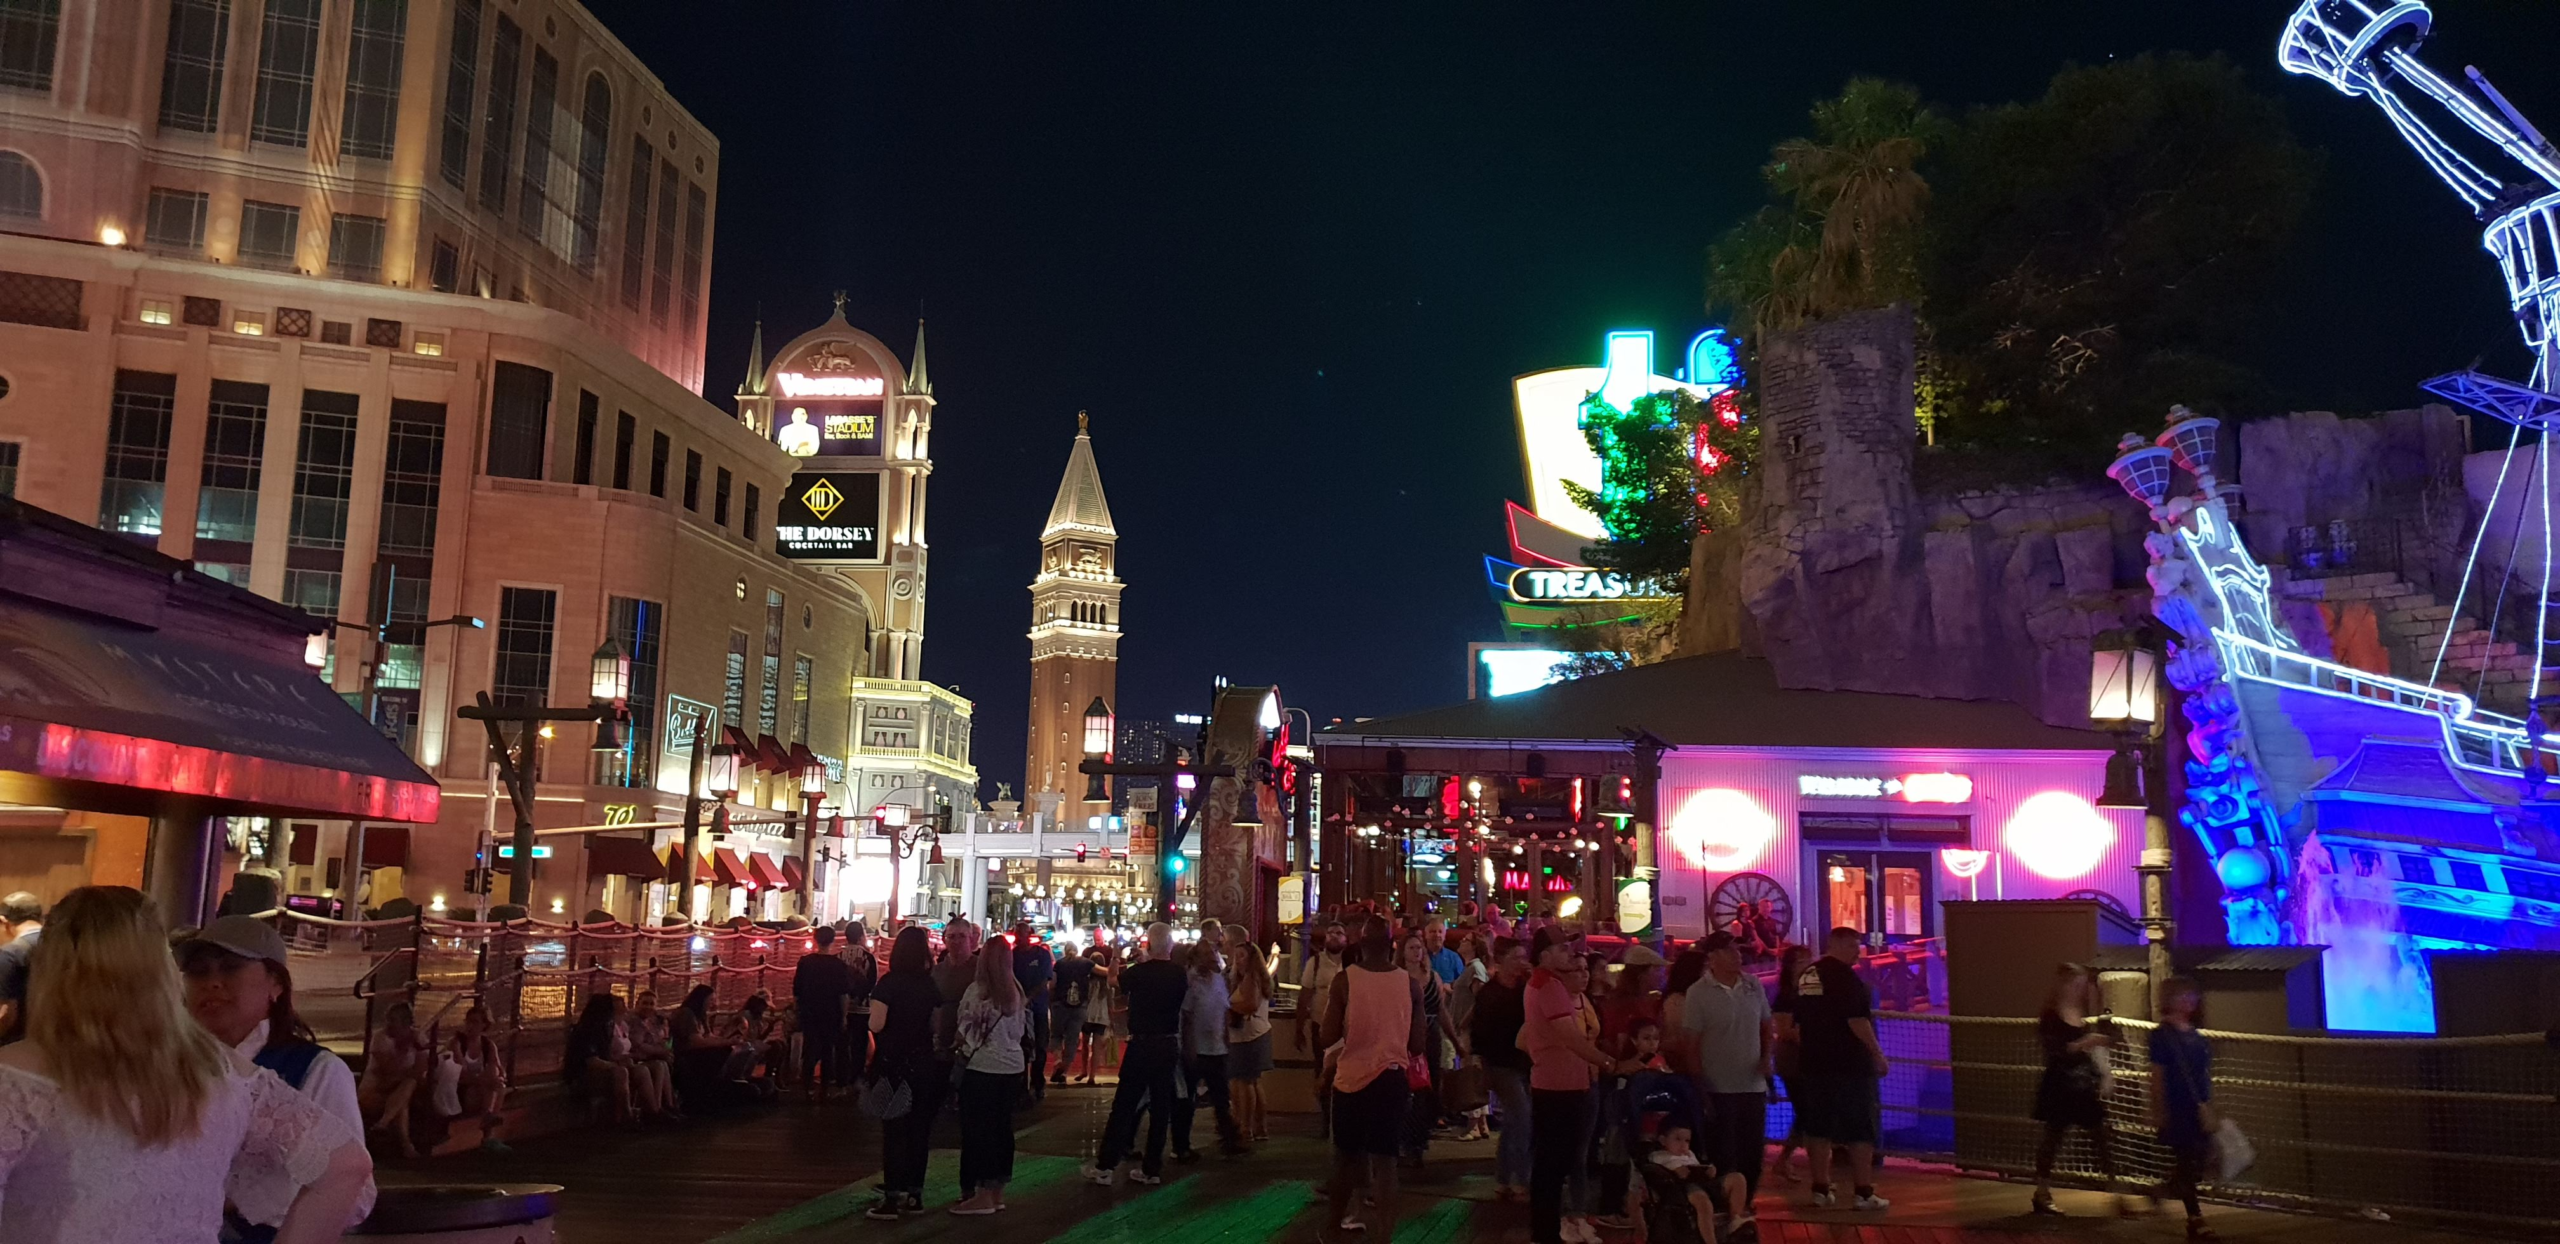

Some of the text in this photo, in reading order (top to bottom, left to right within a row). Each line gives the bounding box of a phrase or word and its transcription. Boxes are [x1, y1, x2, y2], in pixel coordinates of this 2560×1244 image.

[825, 423, 873, 433] STADIUM
[807, 526, 873, 541] DORSEY
[1529, 571, 1684, 598] TREASUR
